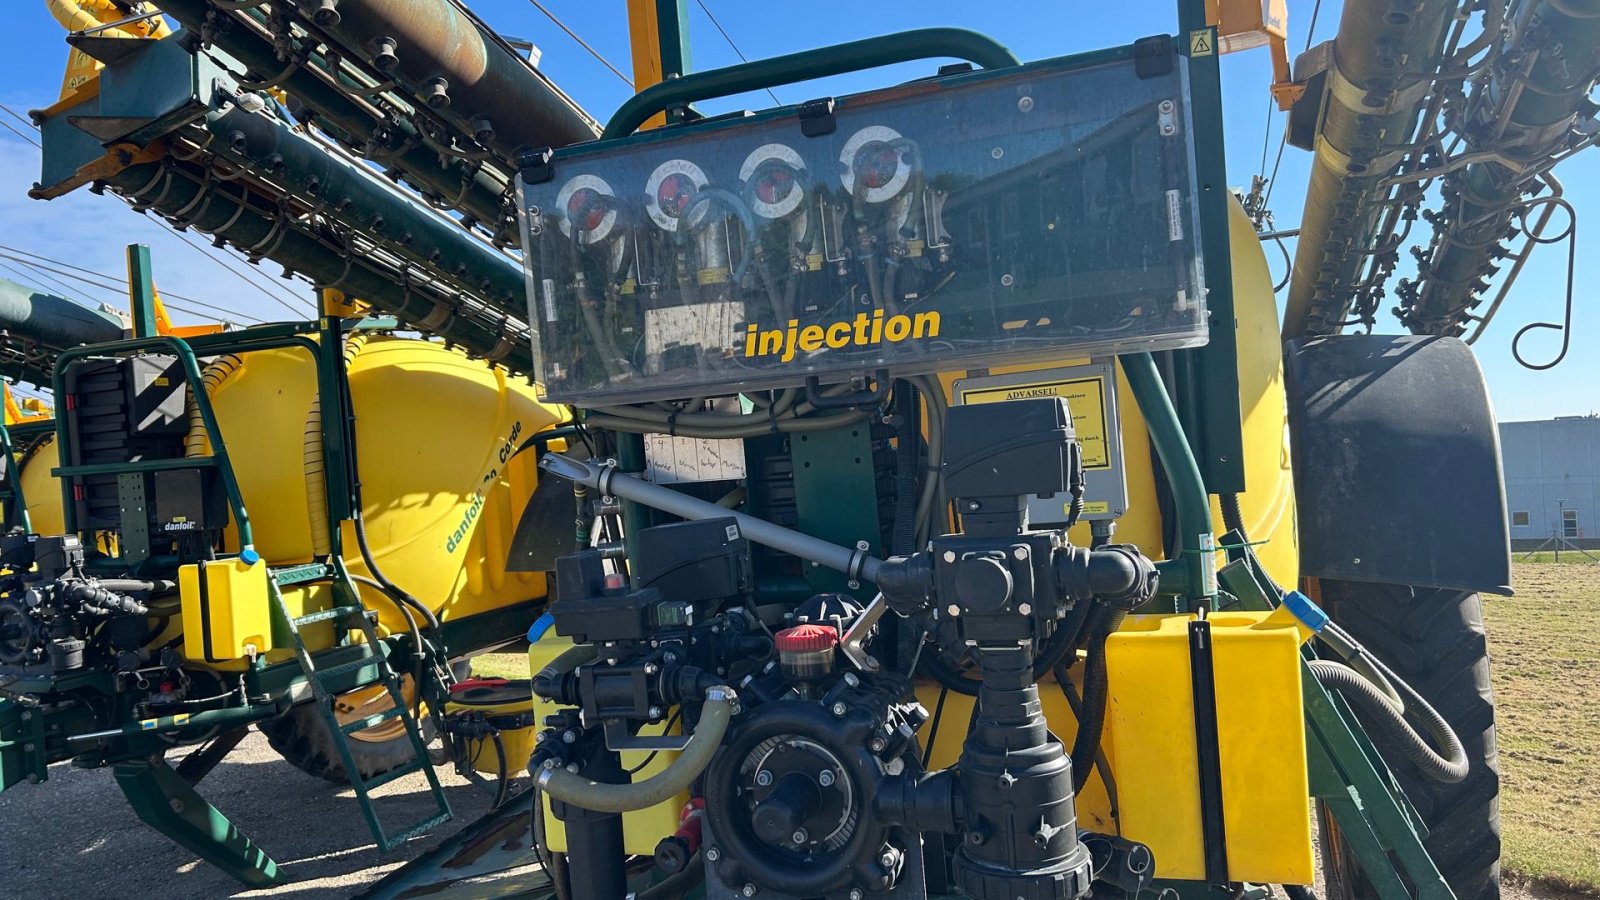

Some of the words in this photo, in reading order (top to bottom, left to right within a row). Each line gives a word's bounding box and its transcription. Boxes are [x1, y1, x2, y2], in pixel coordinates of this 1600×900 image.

[745, 308, 941, 363] injection
[1006, 388, 1057, 399] ADVARSEL!
[446, 488, 483, 553] danfoil
[499, 421, 522, 464] Corde
[164, 520, 194, 531] danfoil
